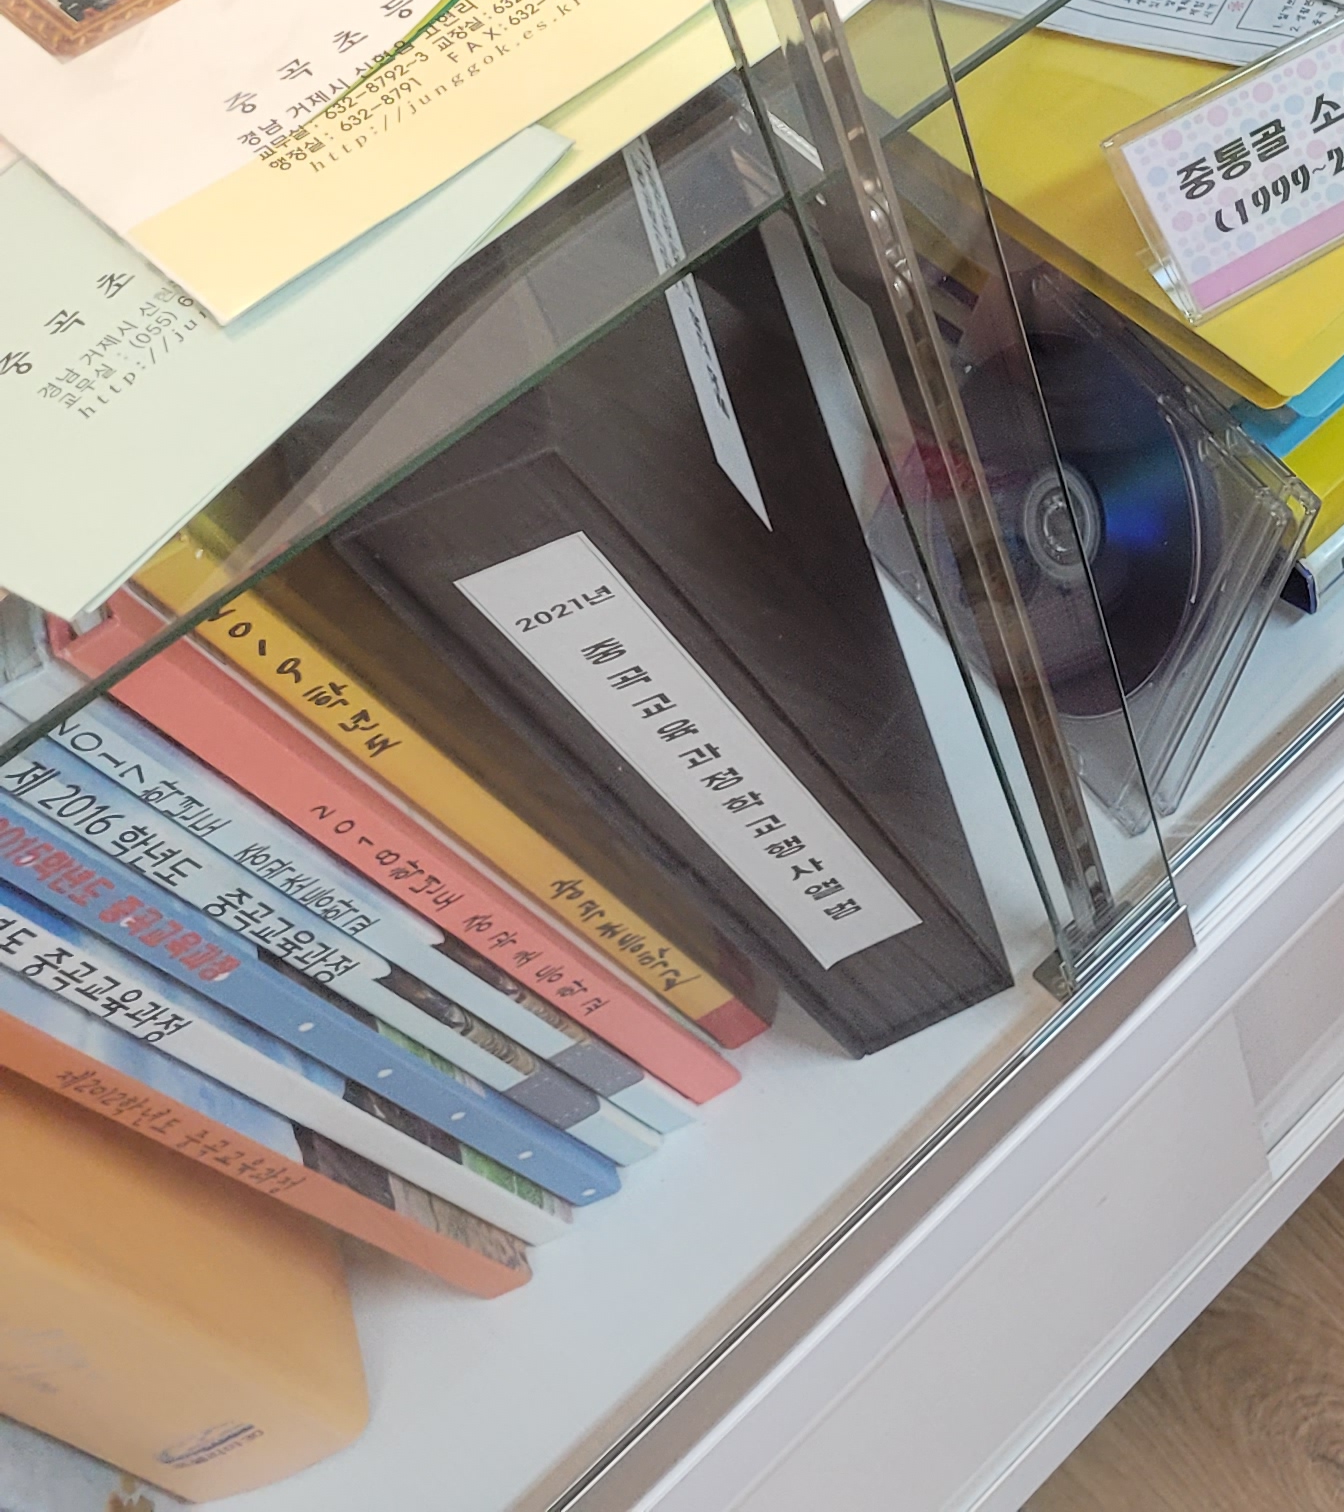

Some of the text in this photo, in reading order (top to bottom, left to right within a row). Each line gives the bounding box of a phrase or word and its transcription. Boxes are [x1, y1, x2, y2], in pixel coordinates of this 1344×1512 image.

[237, 118, 284, 147] 경남
[286, 78, 351, 119] 거제시
[324, 50, 430, 121] 632-8792~3
[340, 77, 424, 133] 632-8791
[1176, 118, 1290, 201] 중통골
[37, 367, 81, 399] 경남
[80, 320, 139, 366] 거제시
[129, 310, 178, 349] (055)
[514, 584, 616, 634] 2021년
[5, 760, 362, 985] 제 2016 학년도 중곡교육과정
[232, 841, 382, 935] 중곡초등학교
[309, 805, 611, 1018] 2018학년도 중곡초등학교
[20, 946, 194, 1045] 중곡교육과정
[174, 1127, 308, 1196] 중곡교육과정
